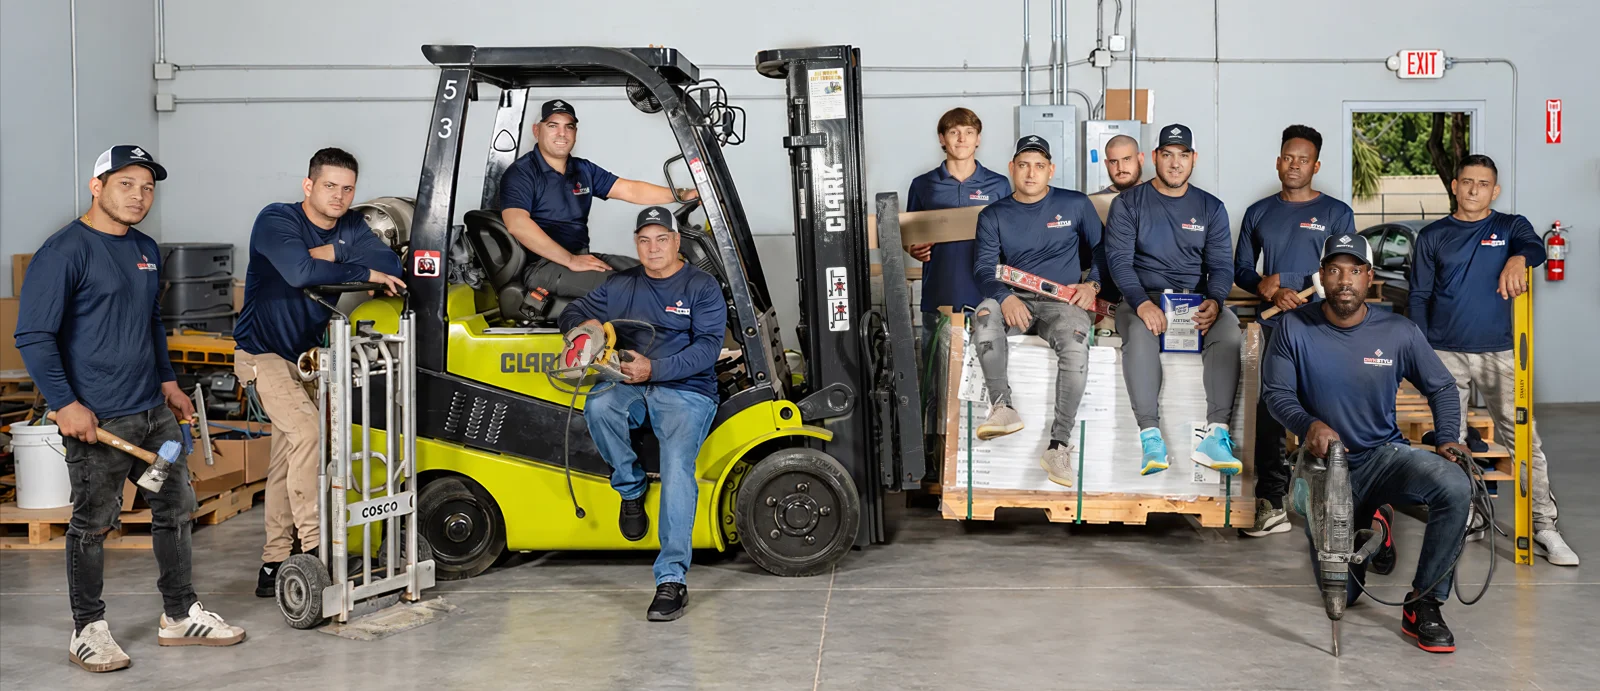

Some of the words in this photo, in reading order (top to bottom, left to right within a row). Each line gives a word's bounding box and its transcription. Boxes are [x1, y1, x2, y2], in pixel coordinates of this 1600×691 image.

[1408, 52, 1437, 75] EXIT
[443, 79, 457, 100] 5
[438, 117, 452, 139] 3
[823, 163, 846, 232] CLARK
[362, 501, 398, 518] COSCO
